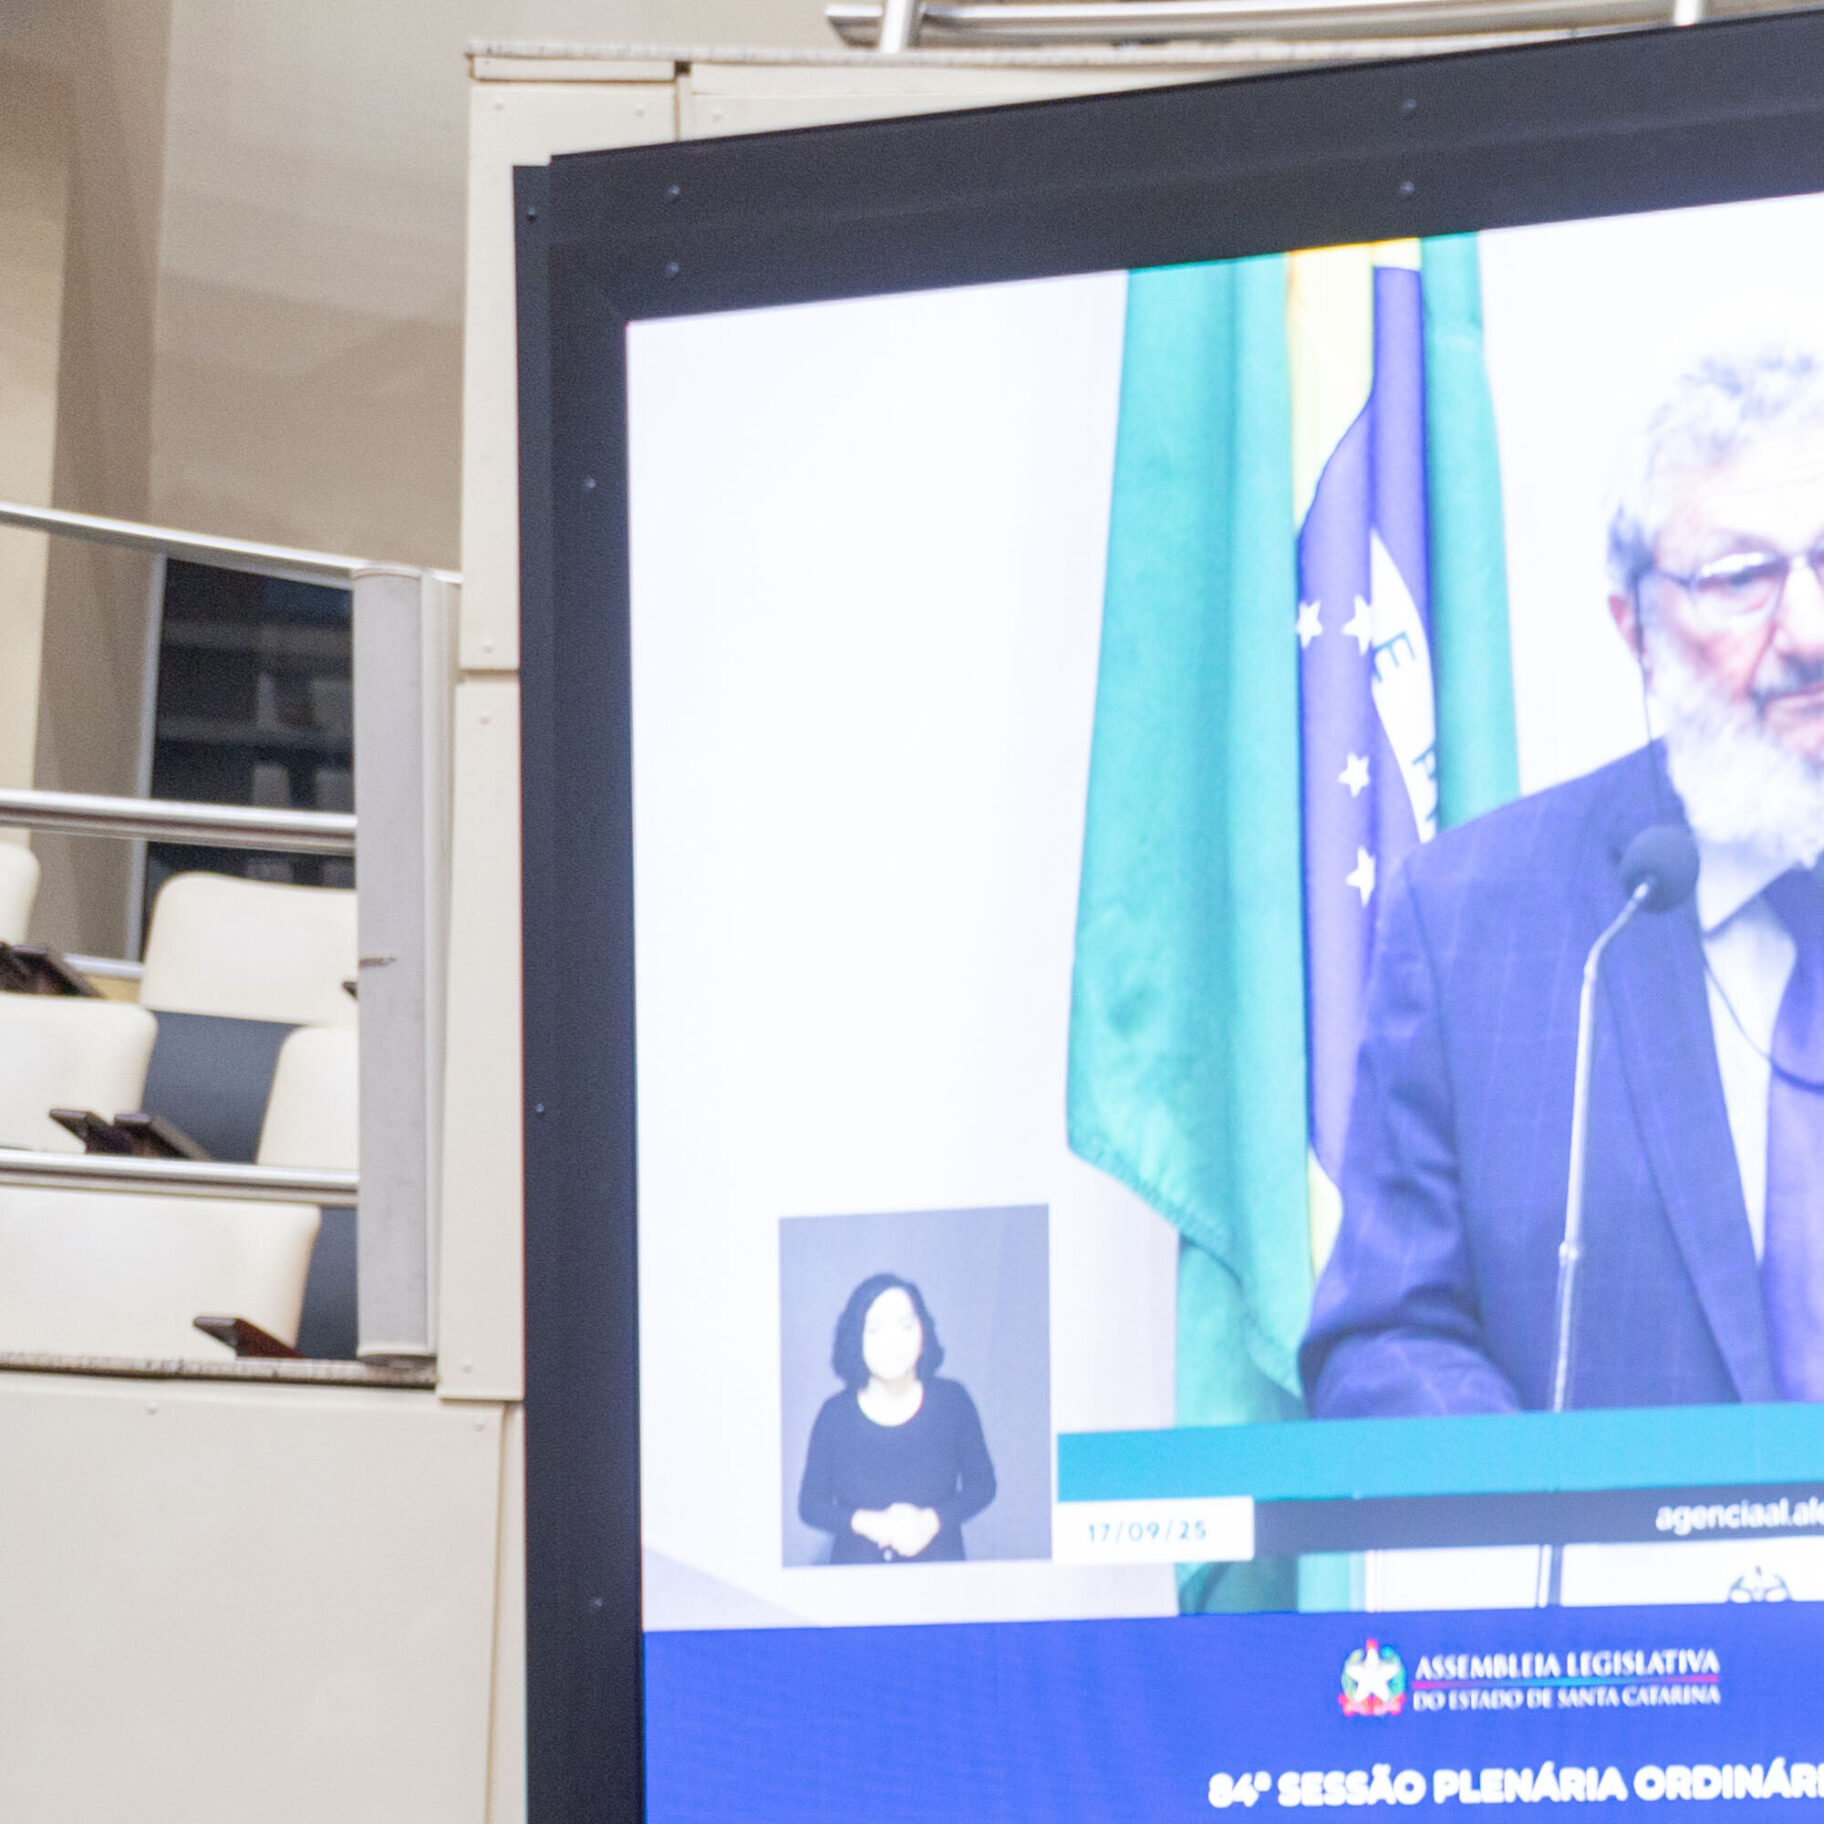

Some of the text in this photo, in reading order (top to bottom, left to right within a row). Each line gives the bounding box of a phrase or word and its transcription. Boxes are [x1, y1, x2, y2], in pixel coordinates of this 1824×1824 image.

[1087, 1519, 1208, 1545] 17/09/25
[1414, 1648, 1721, 1681] ASSEMBLEIA LEGISLATIVA
[1412, 1684, 1722, 1712] DO ESTADO DE SANTA CATARINA
[1277, 1763, 1427, 1807] SESSÃO
[1433, 1761, 1629, 1804] PLENÁRIA
